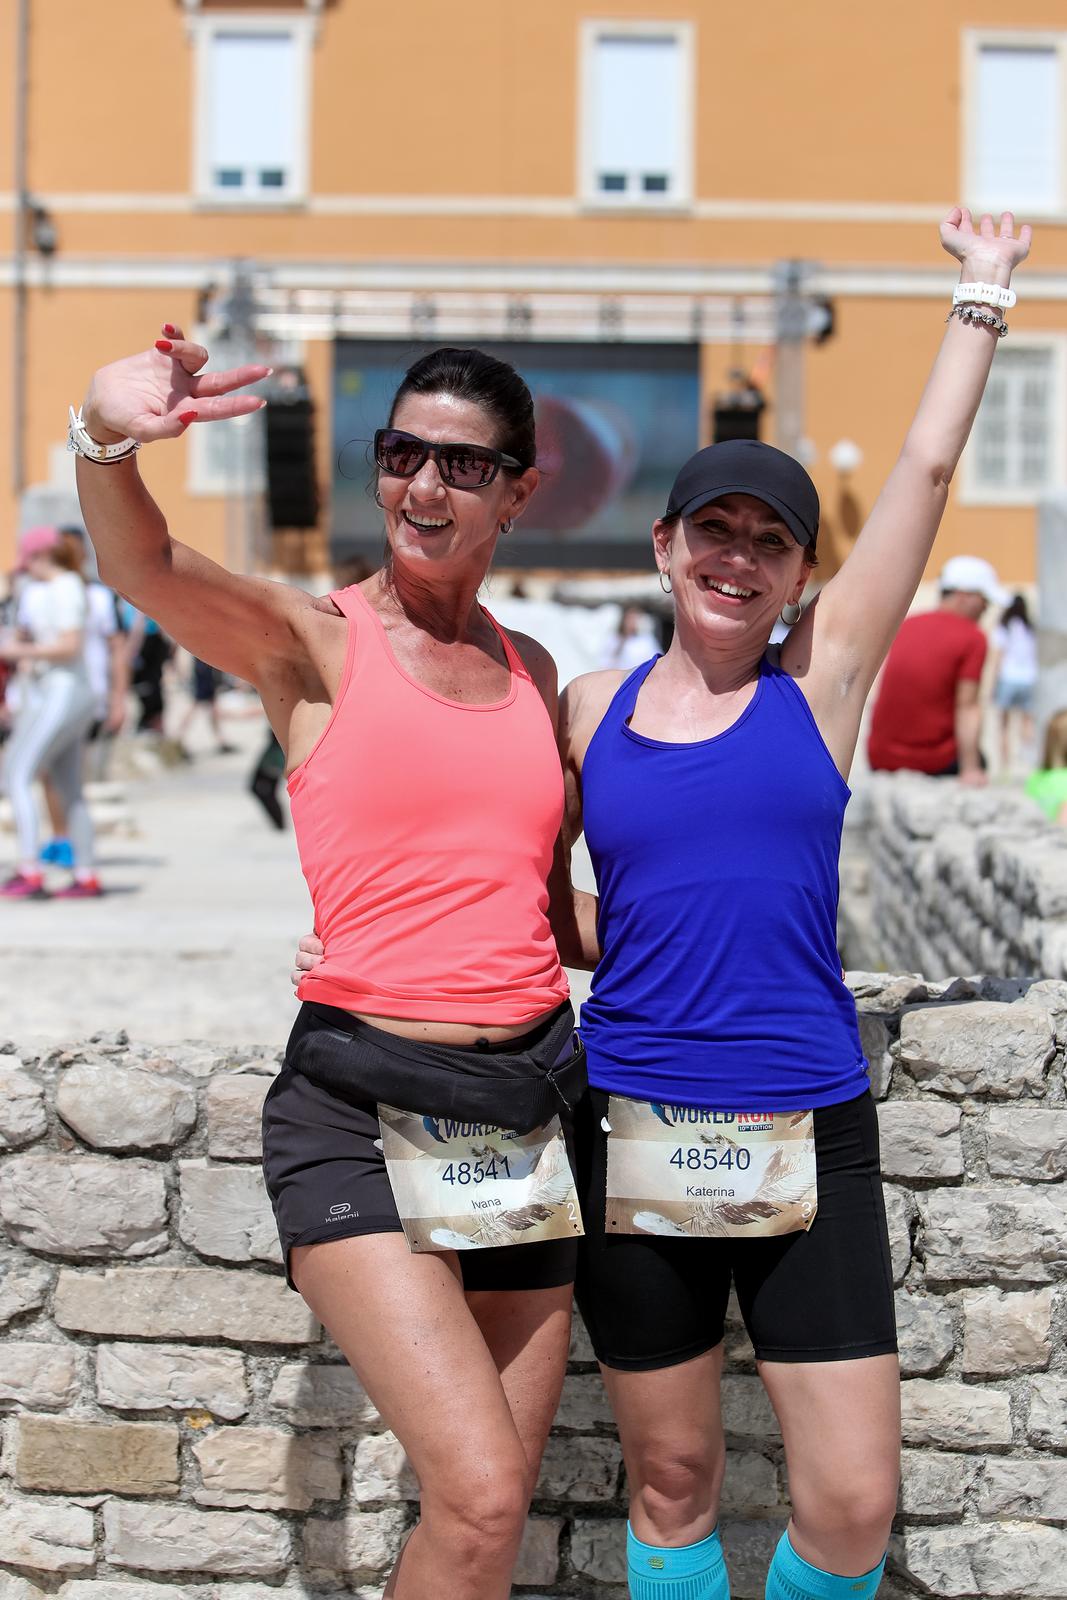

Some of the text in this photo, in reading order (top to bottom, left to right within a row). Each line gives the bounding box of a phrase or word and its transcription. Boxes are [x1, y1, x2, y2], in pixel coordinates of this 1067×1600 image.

[669, 1147, 751, 1170] 48540
[441, 1155, 511, 1185] 48541
[686, 1185, 735, 1197] Katerina
[471, 1196, 502, 1210] Ivana
[566, 1203, 577, 1220] 2
[800, 1201, 812, 1218] 3
